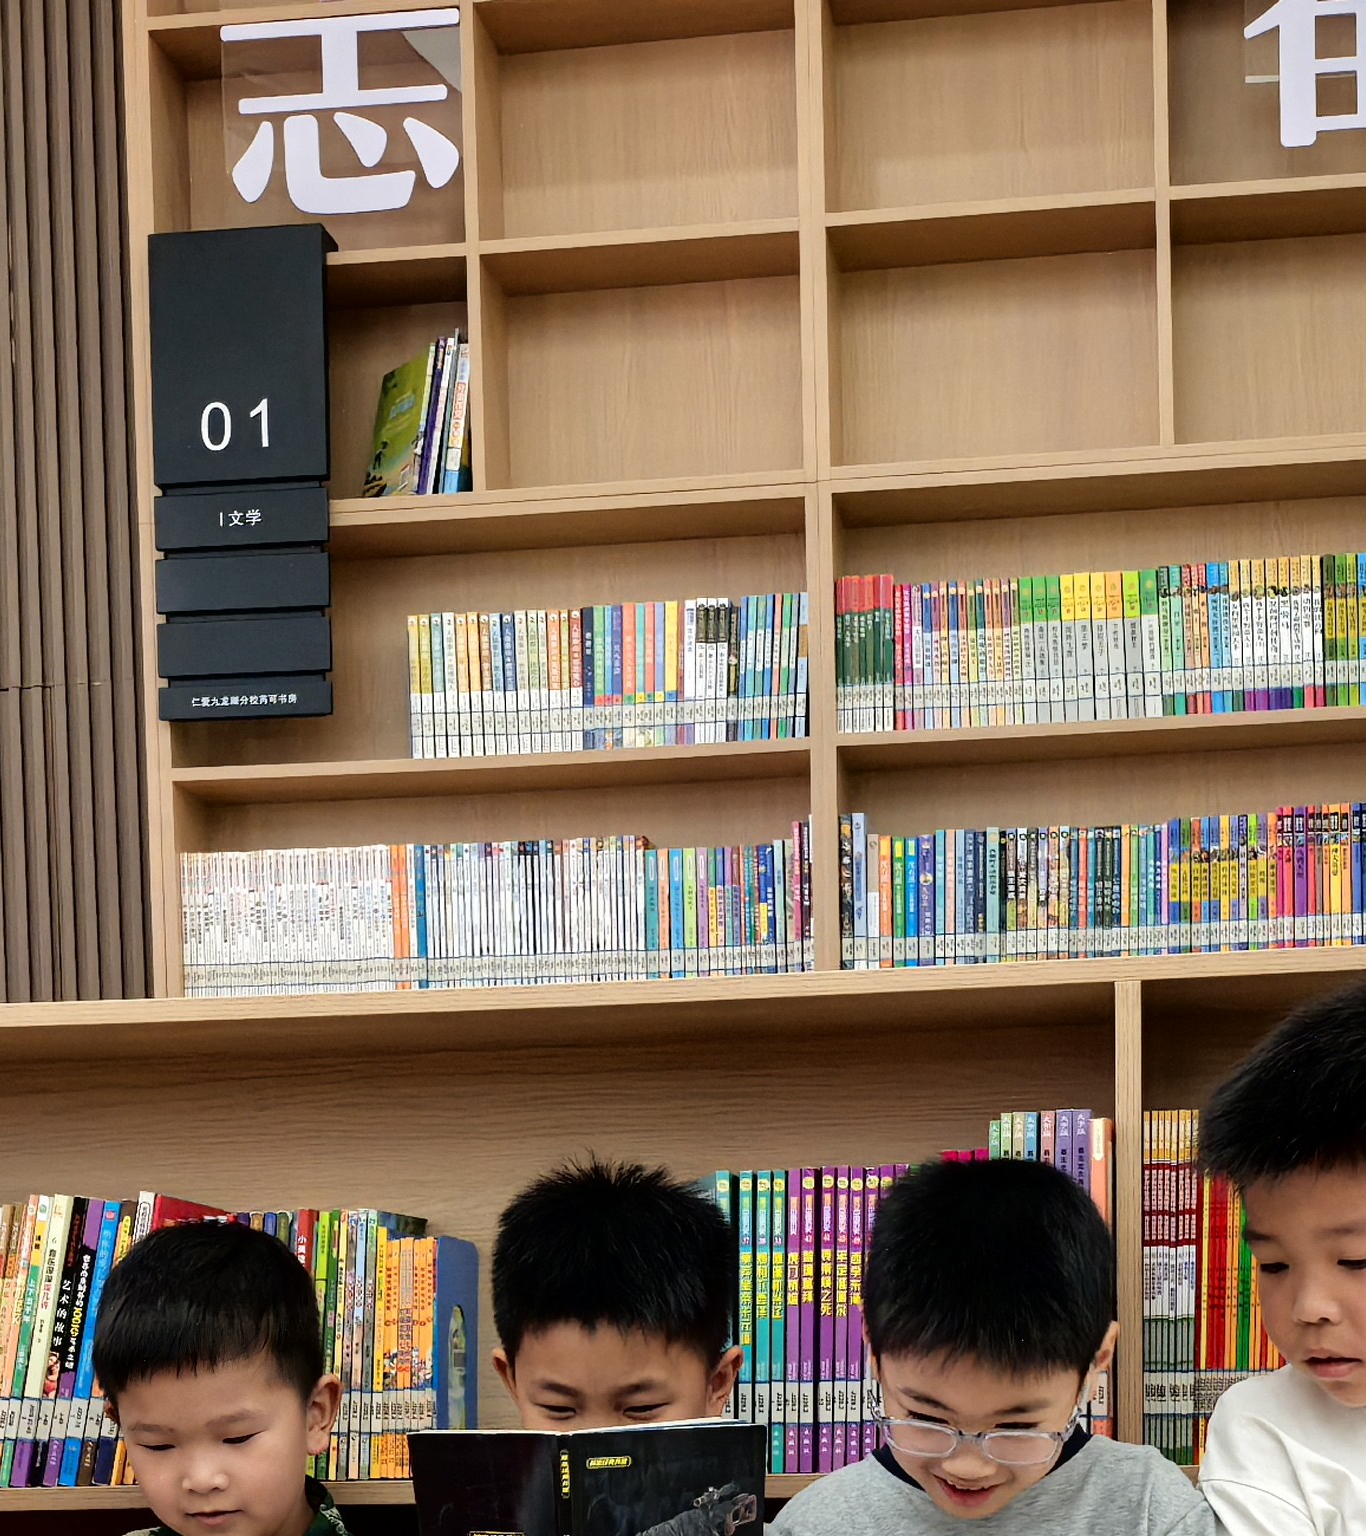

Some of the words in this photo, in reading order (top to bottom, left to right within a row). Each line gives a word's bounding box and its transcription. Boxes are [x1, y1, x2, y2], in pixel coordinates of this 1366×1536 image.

[201, 398, 272, 451] 01
[228, 508, 262, 527] 文学
[51, 1279, 72, 1348] 艺术的故事
